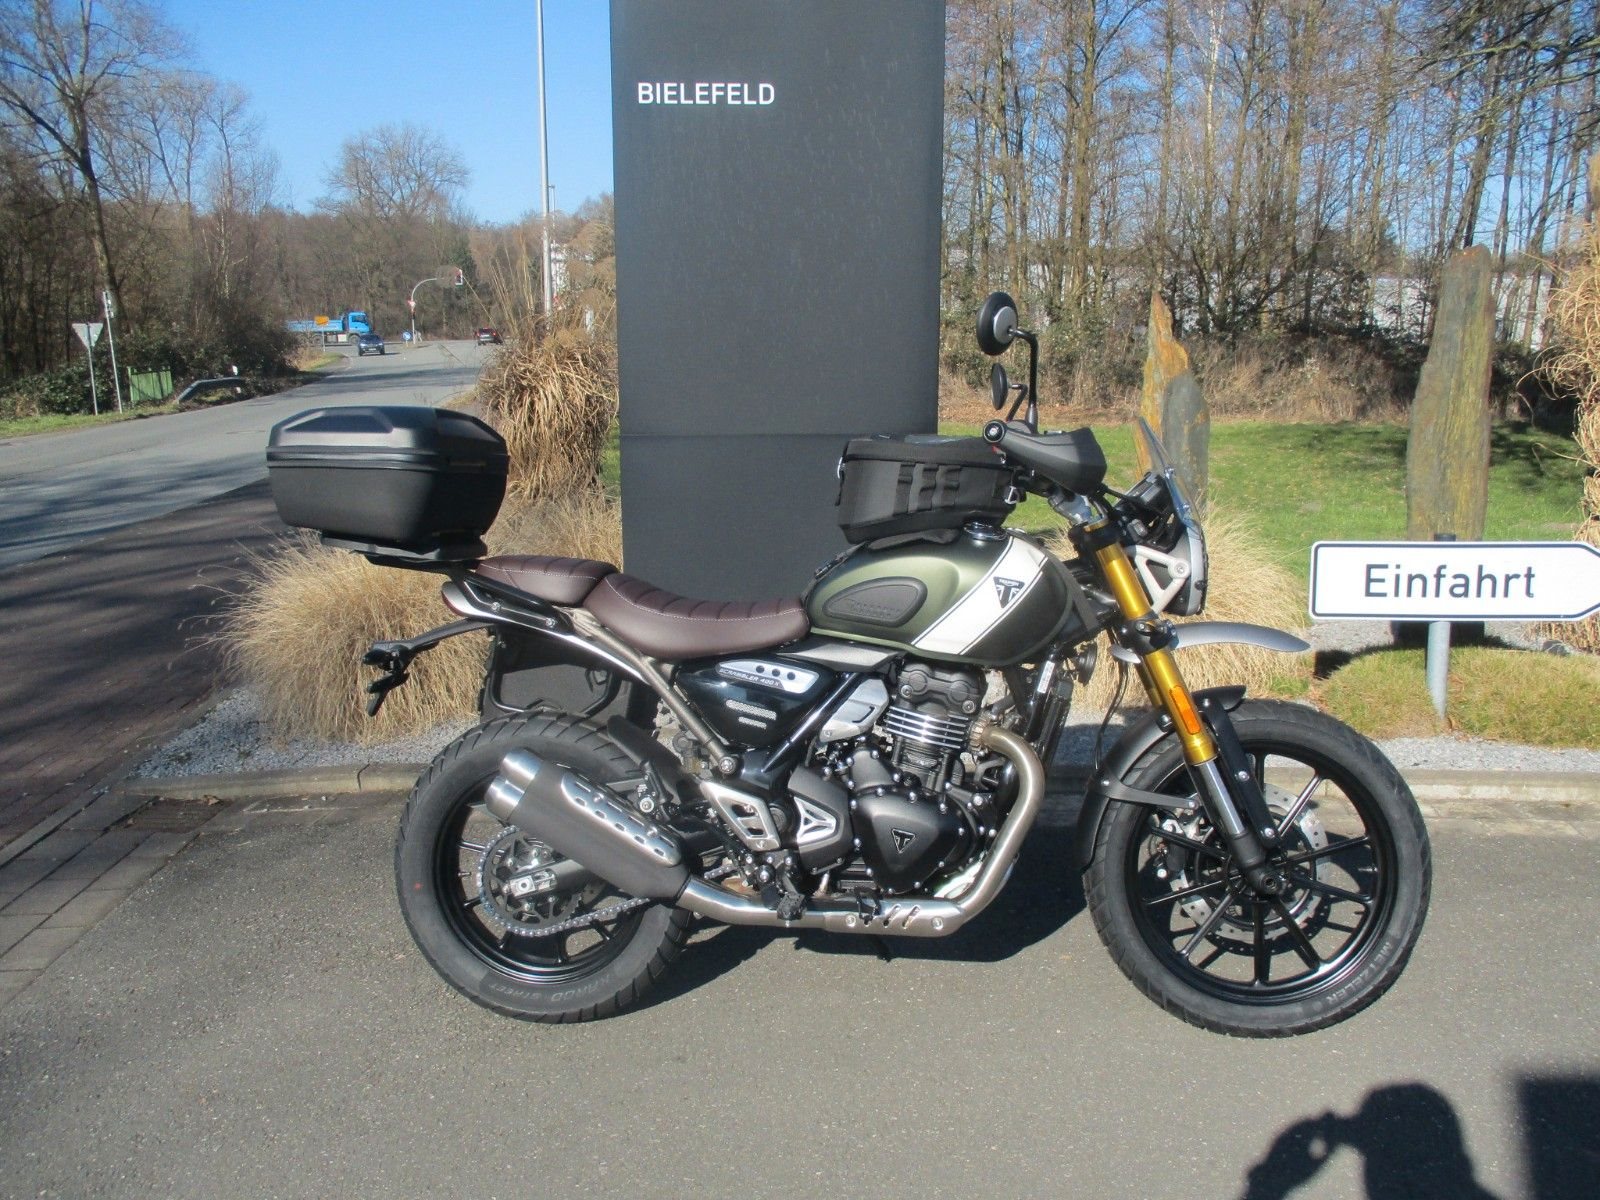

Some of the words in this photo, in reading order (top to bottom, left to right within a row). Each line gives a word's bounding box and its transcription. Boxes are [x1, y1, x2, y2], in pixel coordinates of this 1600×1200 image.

[637, 82, 775, 105] BIELEFELD
[1364, 563, 1536, 598] Einfahrt
[719, 668, 759, 682] SCRAMBLER
